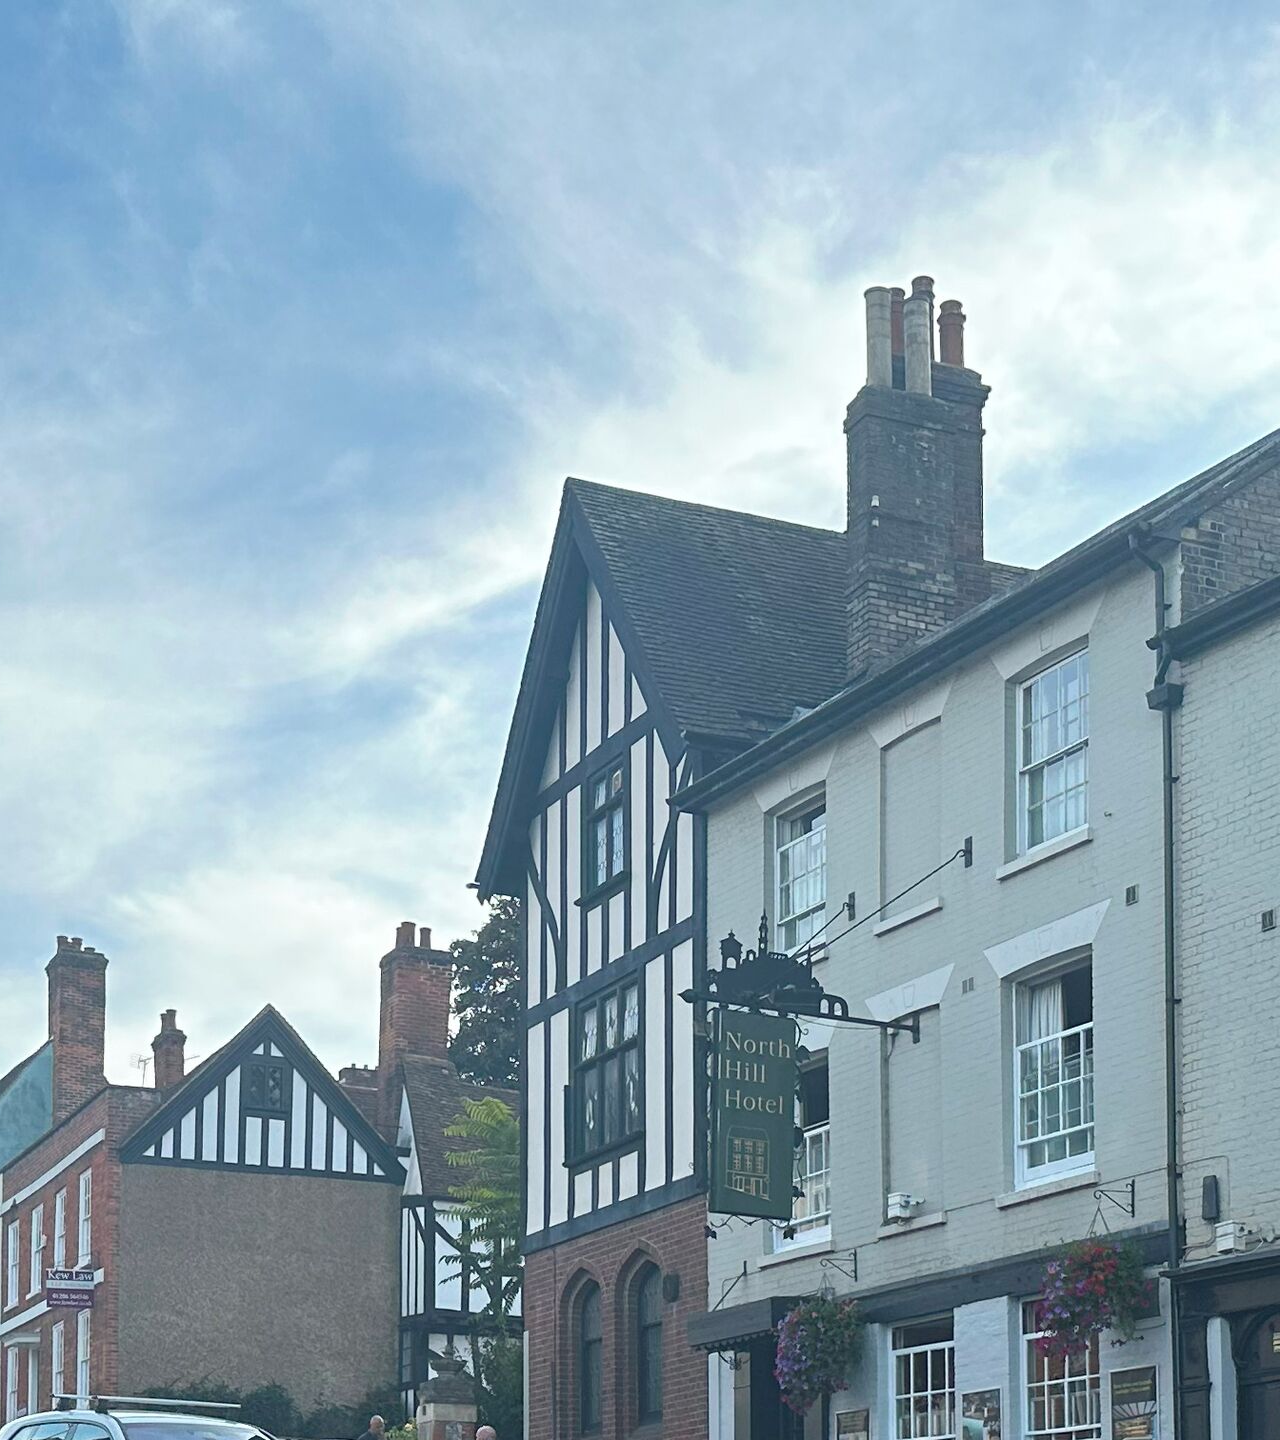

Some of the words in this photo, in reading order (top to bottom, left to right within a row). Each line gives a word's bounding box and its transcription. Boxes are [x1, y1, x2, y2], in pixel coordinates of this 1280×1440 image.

[725, 1031, 791, 1059] North
[725, 1059, 766, 1083] Hill
[725, 1088, 784, 1115] Hotel
[48, 1269, 70, 1280] Kew
[73, 1270, 93, 1281] Law
